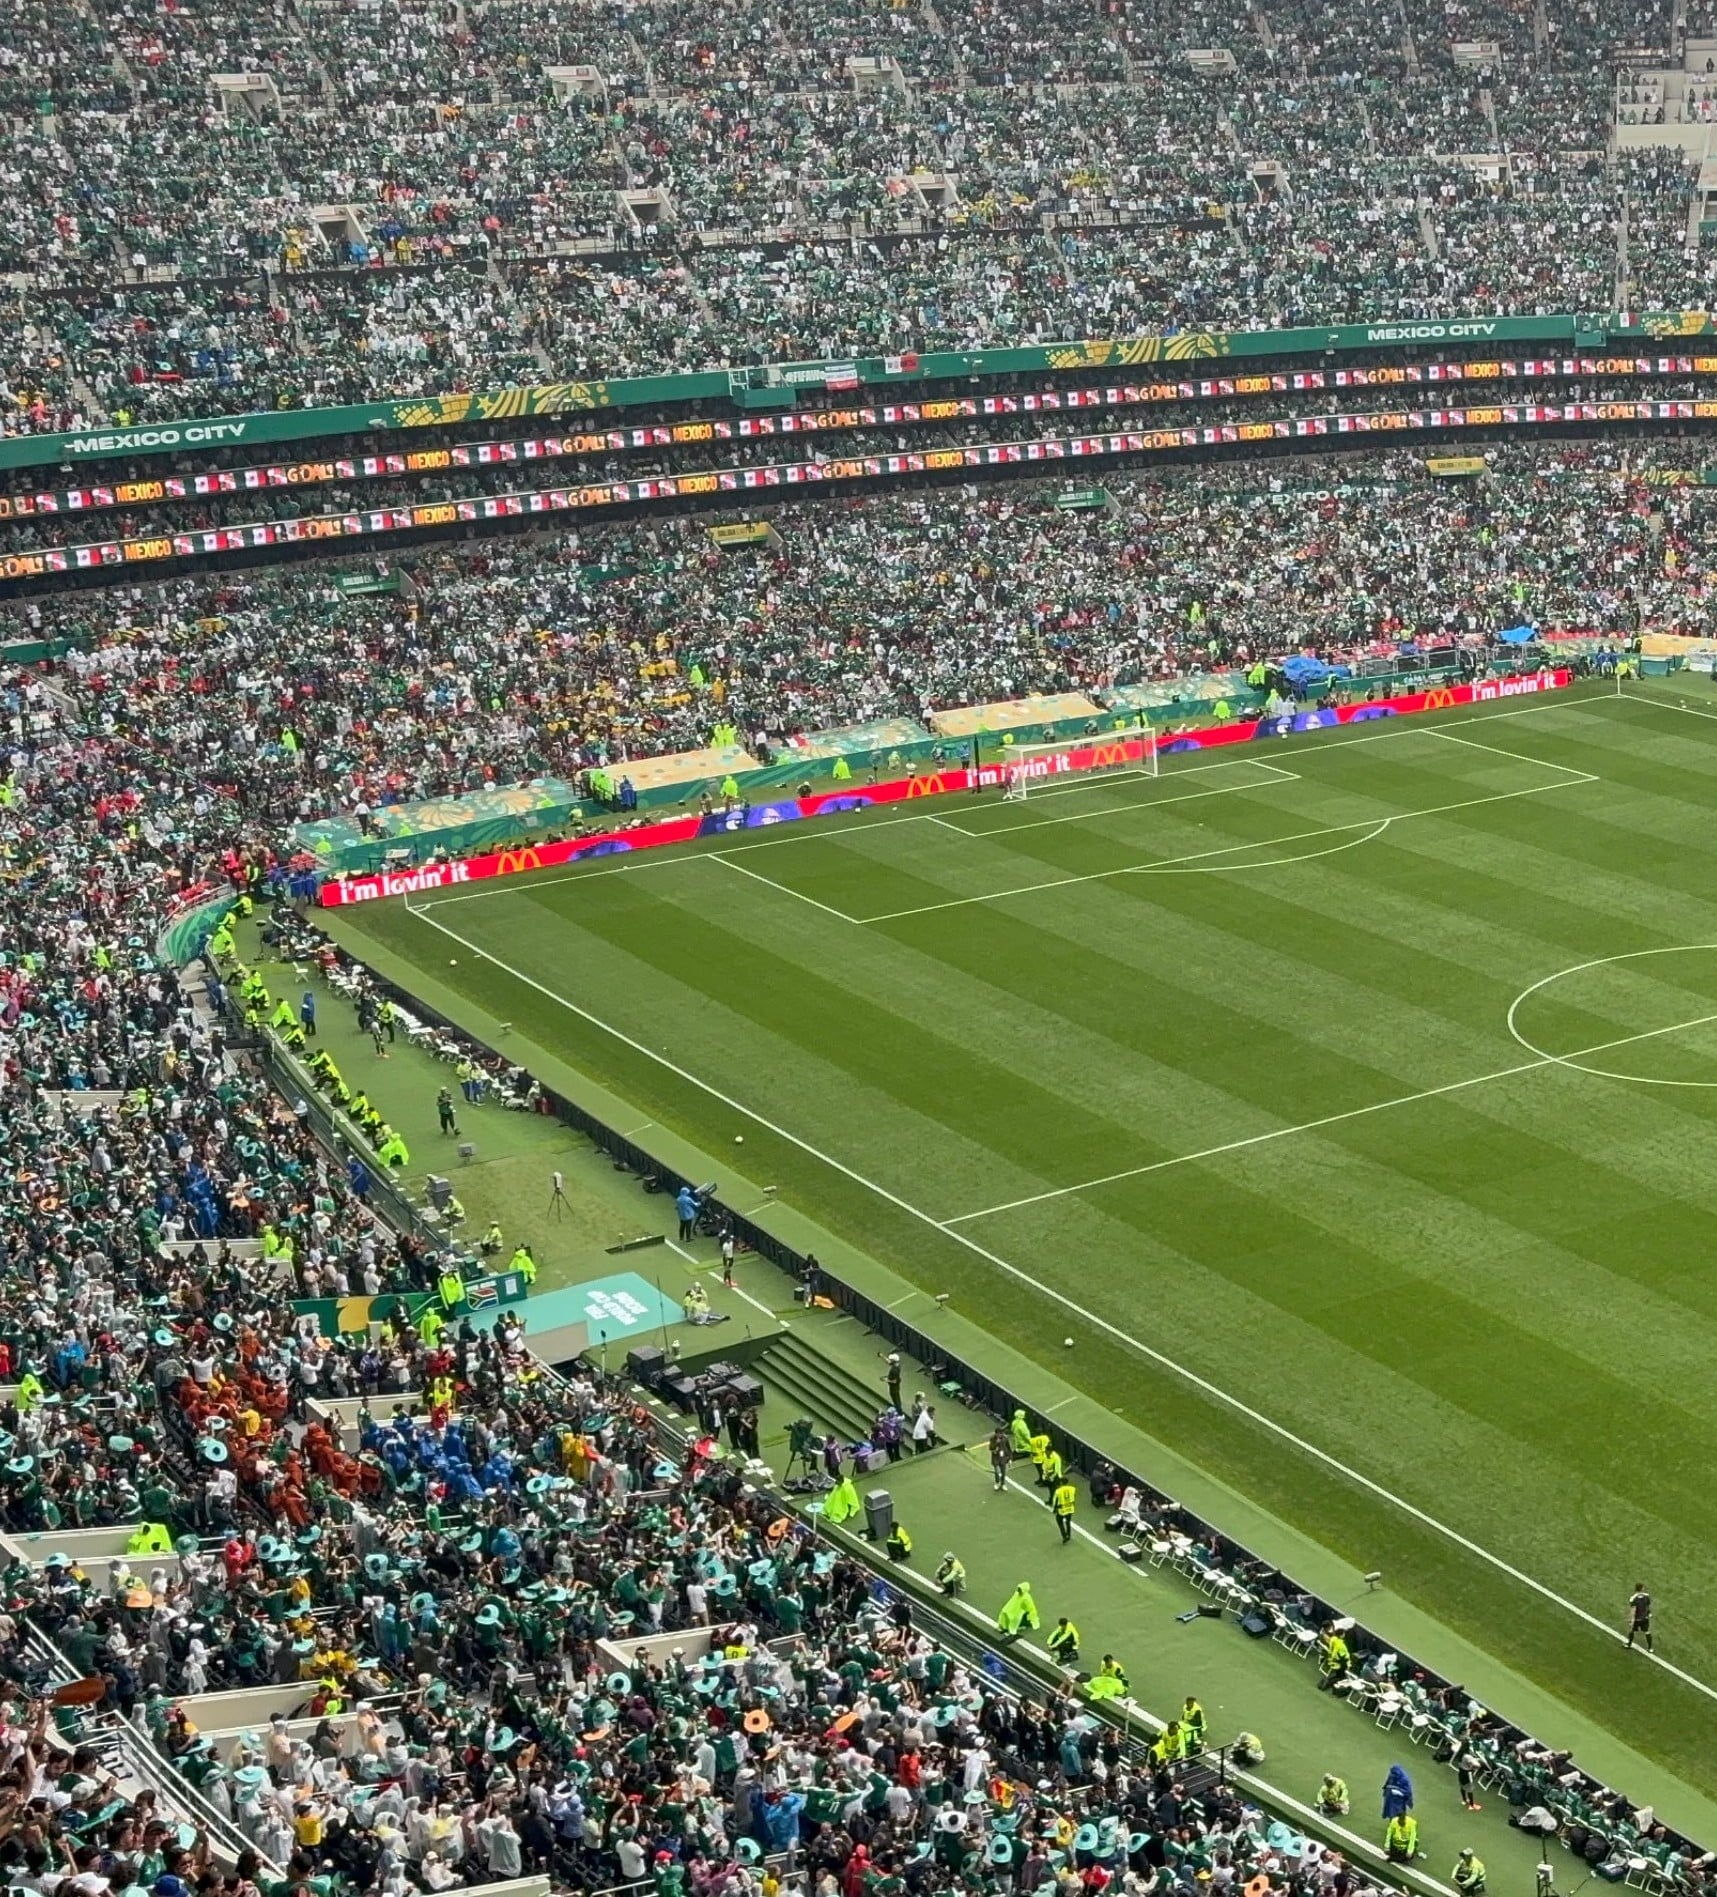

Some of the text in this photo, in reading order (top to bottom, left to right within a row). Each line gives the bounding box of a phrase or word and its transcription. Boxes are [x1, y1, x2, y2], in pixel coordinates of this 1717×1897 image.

[1367, 323, 1496, 341] MEXICO CITY
[1464, 362, 1500, 377] MEXICO
[1236, 377, 1270, 392] MEXICO
[922, 402, 958, 418] MEXICO
[1466, 409, 1501, 424] MEXICO
[72, 423, 246, 453] MEXICO CITY
[673, 424, 712, 442] MEXICO
[1239, 425, 1273, 440] MEXICO
[563, 435, 605, 453] GOAL!
[407, 451, 450, 470] MEXICO
[926, 452, 963, 468] MEXICO
[287, 463, 334, 483] GOAL!
[116, 482, 163, 502] MEXICO
[678, 475, 717, 493] MEXICO
[568, 489, 610, 506] GOAL!
[414, 507, 455, 524] MEXICO
[124, 540, 172, 560] MEXICO
[1472, 673, 1556, 702] i'm lovin' it
[1056, 754, 1070, 771] it
[340, 860, 469, 905] i'm lovin' it
